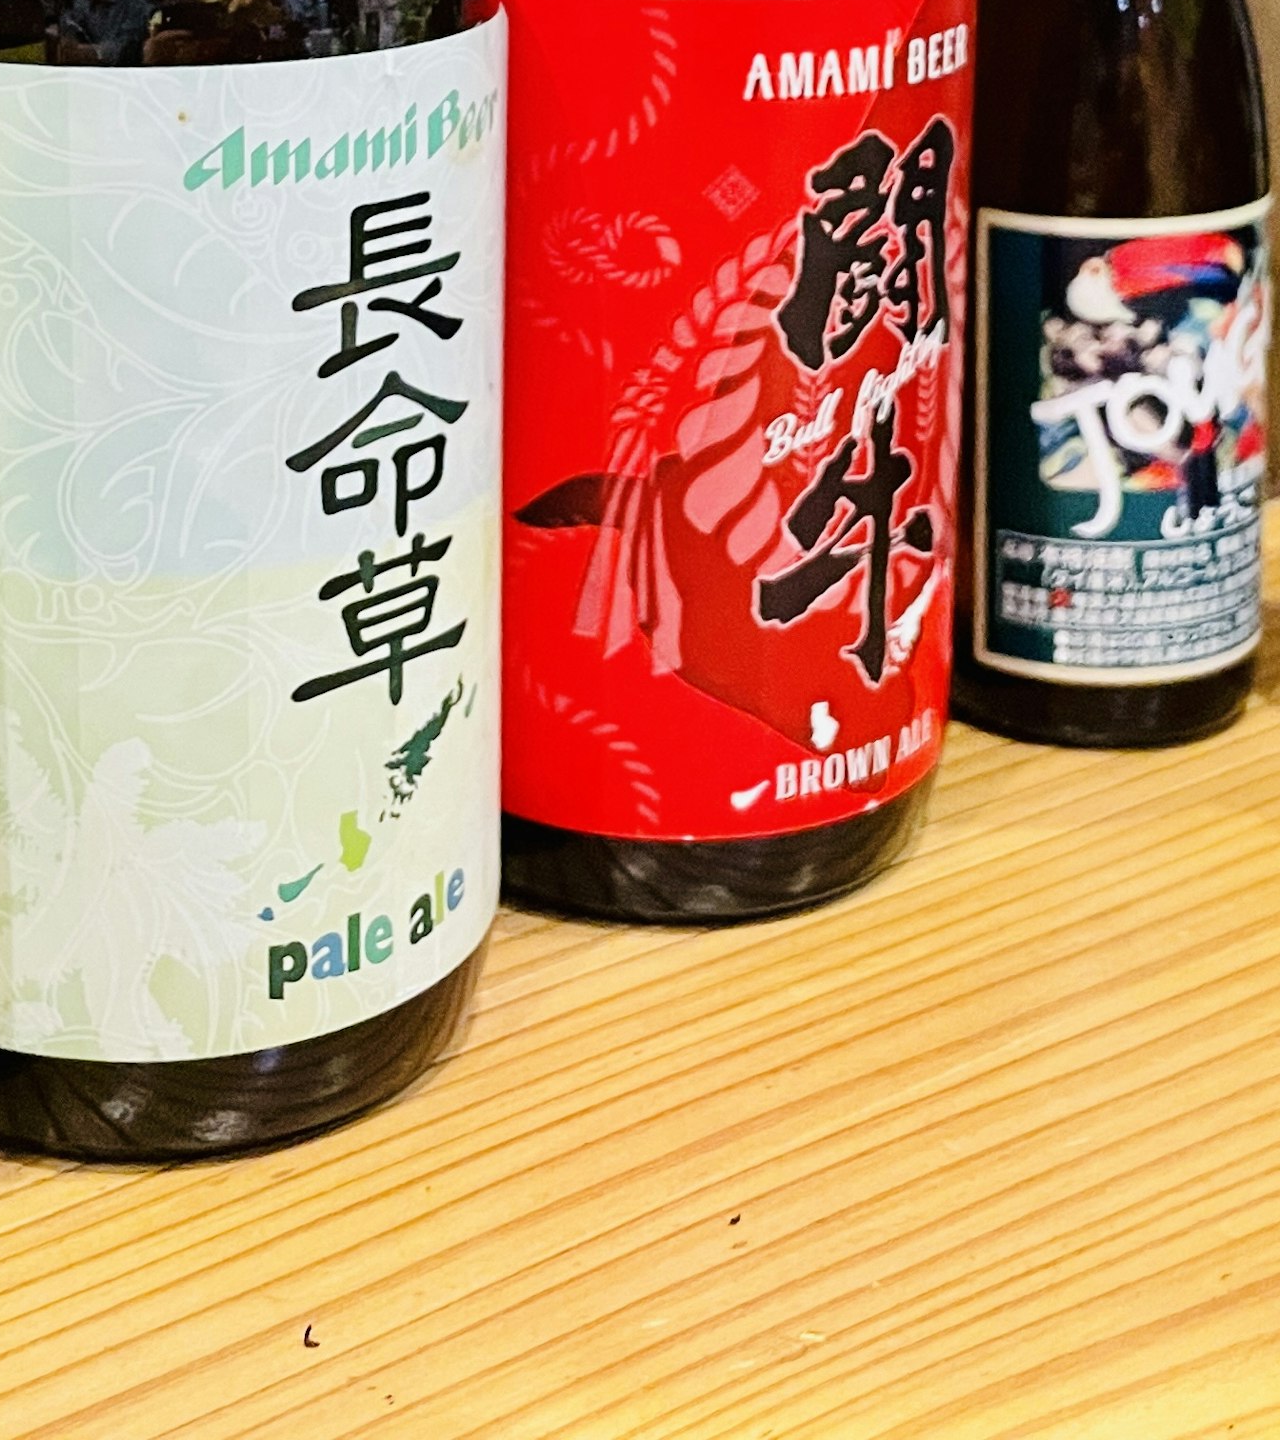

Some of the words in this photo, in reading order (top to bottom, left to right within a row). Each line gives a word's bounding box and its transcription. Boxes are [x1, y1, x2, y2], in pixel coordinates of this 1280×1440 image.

[907, 23, 968, 85] BEER
[183, 101, 417, 192] Amami
[427, 88, 498, 160] Beer
[286, 190, 470, 705] 長命草
[761, 387, 844, 466] Bull
[775, 734, 892, 801] BROWN
[894, 706, 935, 764] ALE
[269, 912, 394, 1000] pale
[409, 868, 465, 945] ale
